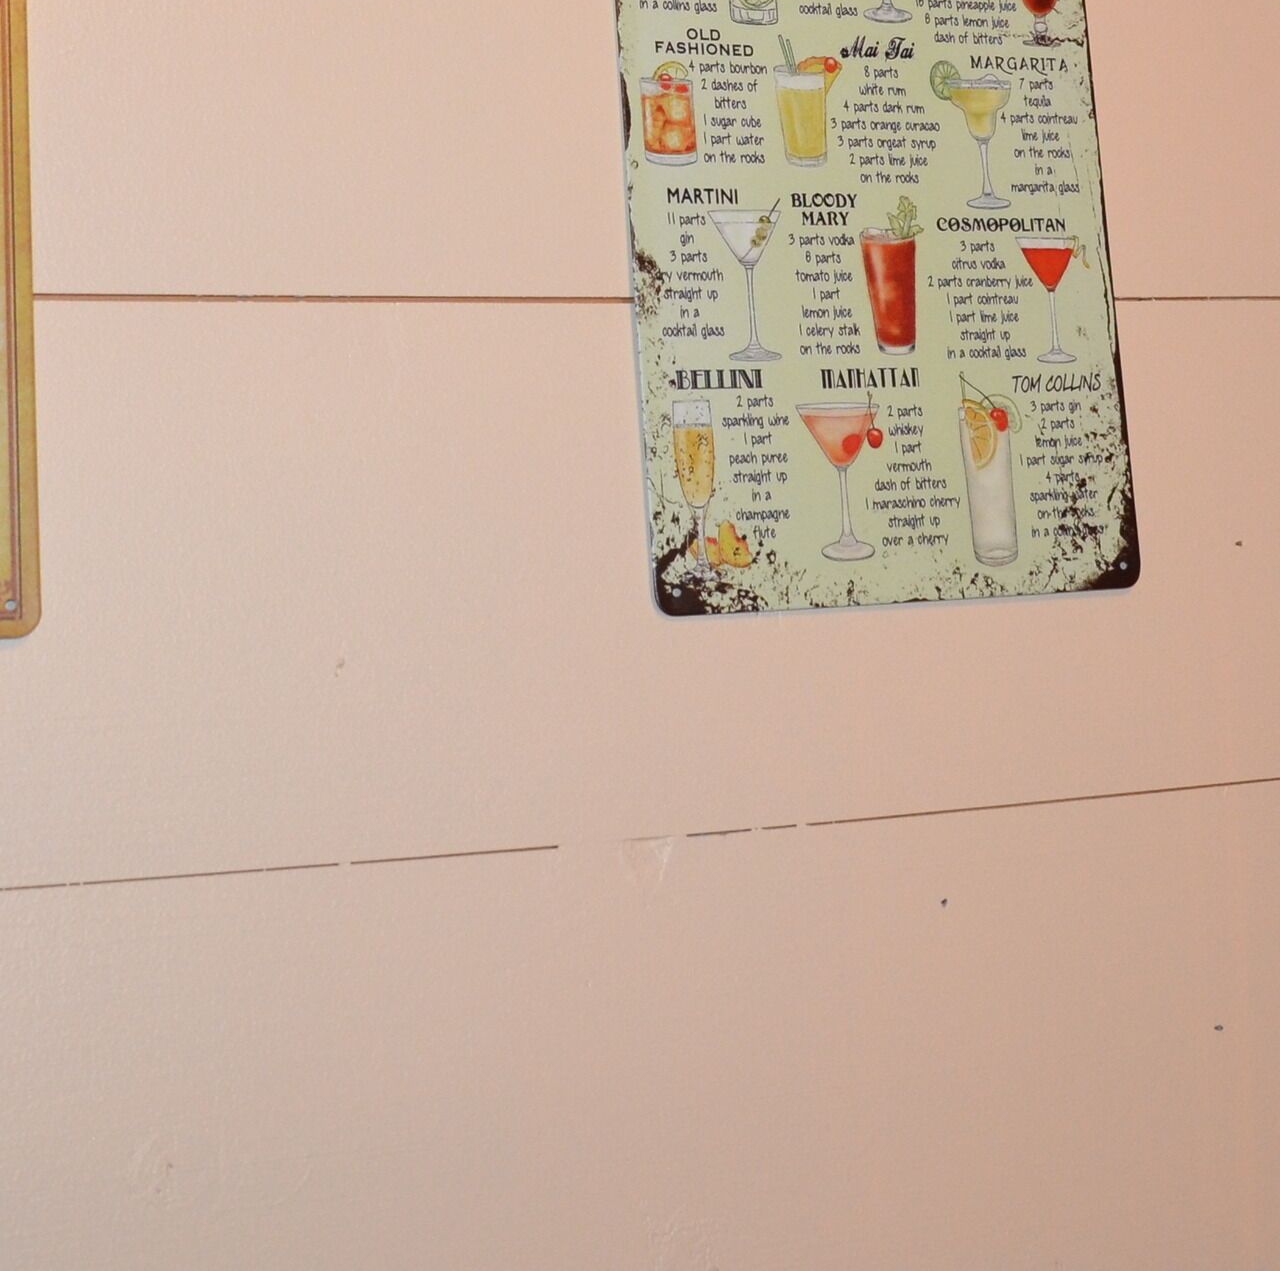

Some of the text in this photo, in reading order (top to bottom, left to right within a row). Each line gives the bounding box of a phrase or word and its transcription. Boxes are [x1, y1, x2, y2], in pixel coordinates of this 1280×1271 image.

[686, 28, 720, 41] OLD
[655, 41, 754, 57] FASHIONED
[839, 35, 915, 61] Mai Tai
[689, 61, 767, 75] 4 parts bourbon
[970, 55, 1069, 76] MARGARITA
[859, 86, 907, 97] white rum
[1023, 95, 1052, 108] tequila
[711, 117, 737, 129] sugar
[741, 117, 761, 128] cube
[831, 119, 940, 132] 3 parts orange curacao
[1011, 182, 1080, 196] margarita glass
[667, 188, 739, 205] MARTINI
[791, 193, 857, 209] BLOODY
[801, 211, 849, 227] MARY
[936, 217, 1066, 233] COSMOPOLITAN
[788, 233, 855, 246] 3 parts vodka
[952, 258, 1006, 269] citrus vodka
[796, 270, 853, 283] tomato juice
[928, 276, 1033, 289] 2 parts cranberry juice
[675, 369, 764, 390] BELLINI
[821, 367, 920, 389] MANHATTAN
[1012, 374, 1102, 394] TOM COLLINS
[722, 415, 790, 428] sparkling wine
[886, 460, 932, 473] vermouth
